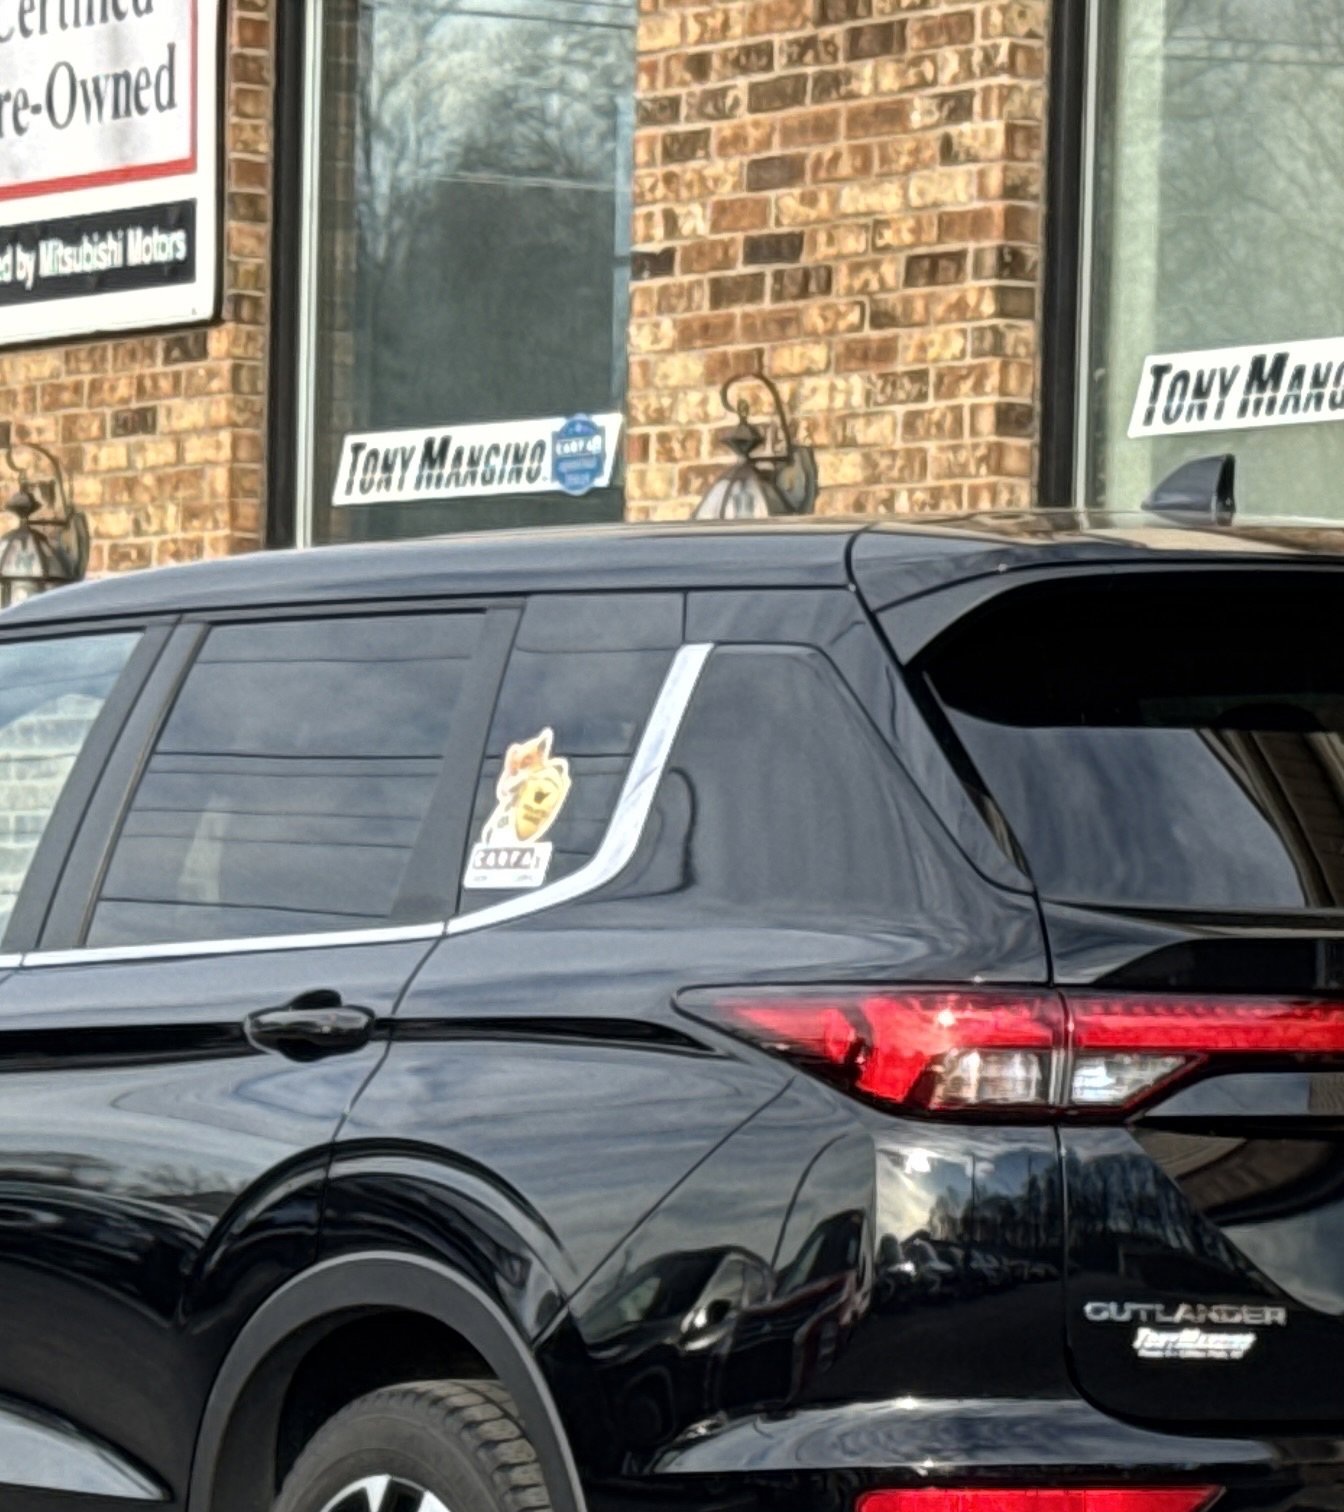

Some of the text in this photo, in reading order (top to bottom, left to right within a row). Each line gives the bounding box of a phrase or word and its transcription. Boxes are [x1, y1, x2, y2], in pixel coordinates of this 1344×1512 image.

[16, 243, 35, 291] by
[39, 229, 124, 278] Mitsubishi
[126, 225, 187, 267] Motors
[1143, 363, 1240, 426] TONY
[345, 442, 416, 495] TONY
[1083, 1301, 1288, 1327] OUTLANDER
